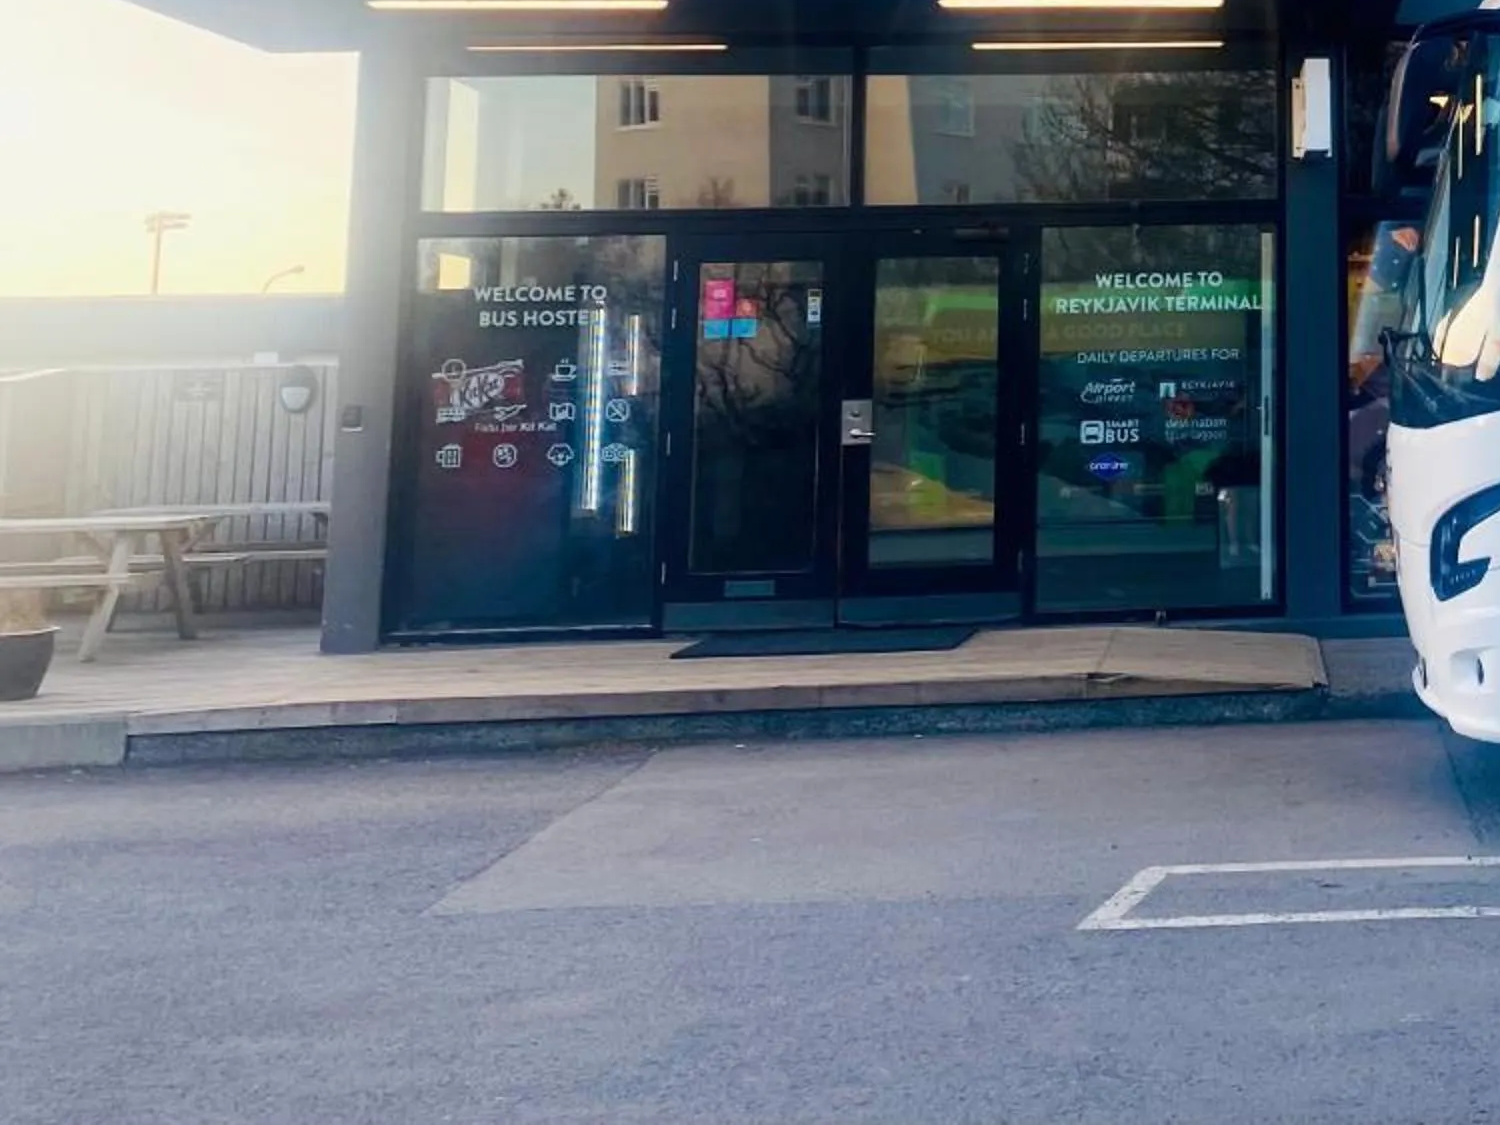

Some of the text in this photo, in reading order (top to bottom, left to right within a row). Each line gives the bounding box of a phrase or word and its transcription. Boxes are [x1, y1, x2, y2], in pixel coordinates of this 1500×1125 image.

[1095, 271, 1223, 289] WELCOME TO
[474, 285, 607, 303] WELCOME TO
[1055, 294, 1263, 314] REYKJAVIK TERMINAL
[479, 311, 518, 327] BUS
[1077, 348, 1240, 364] DAILY DEPARTURES FOR
[1105, 428, 1141, 443] BUS
